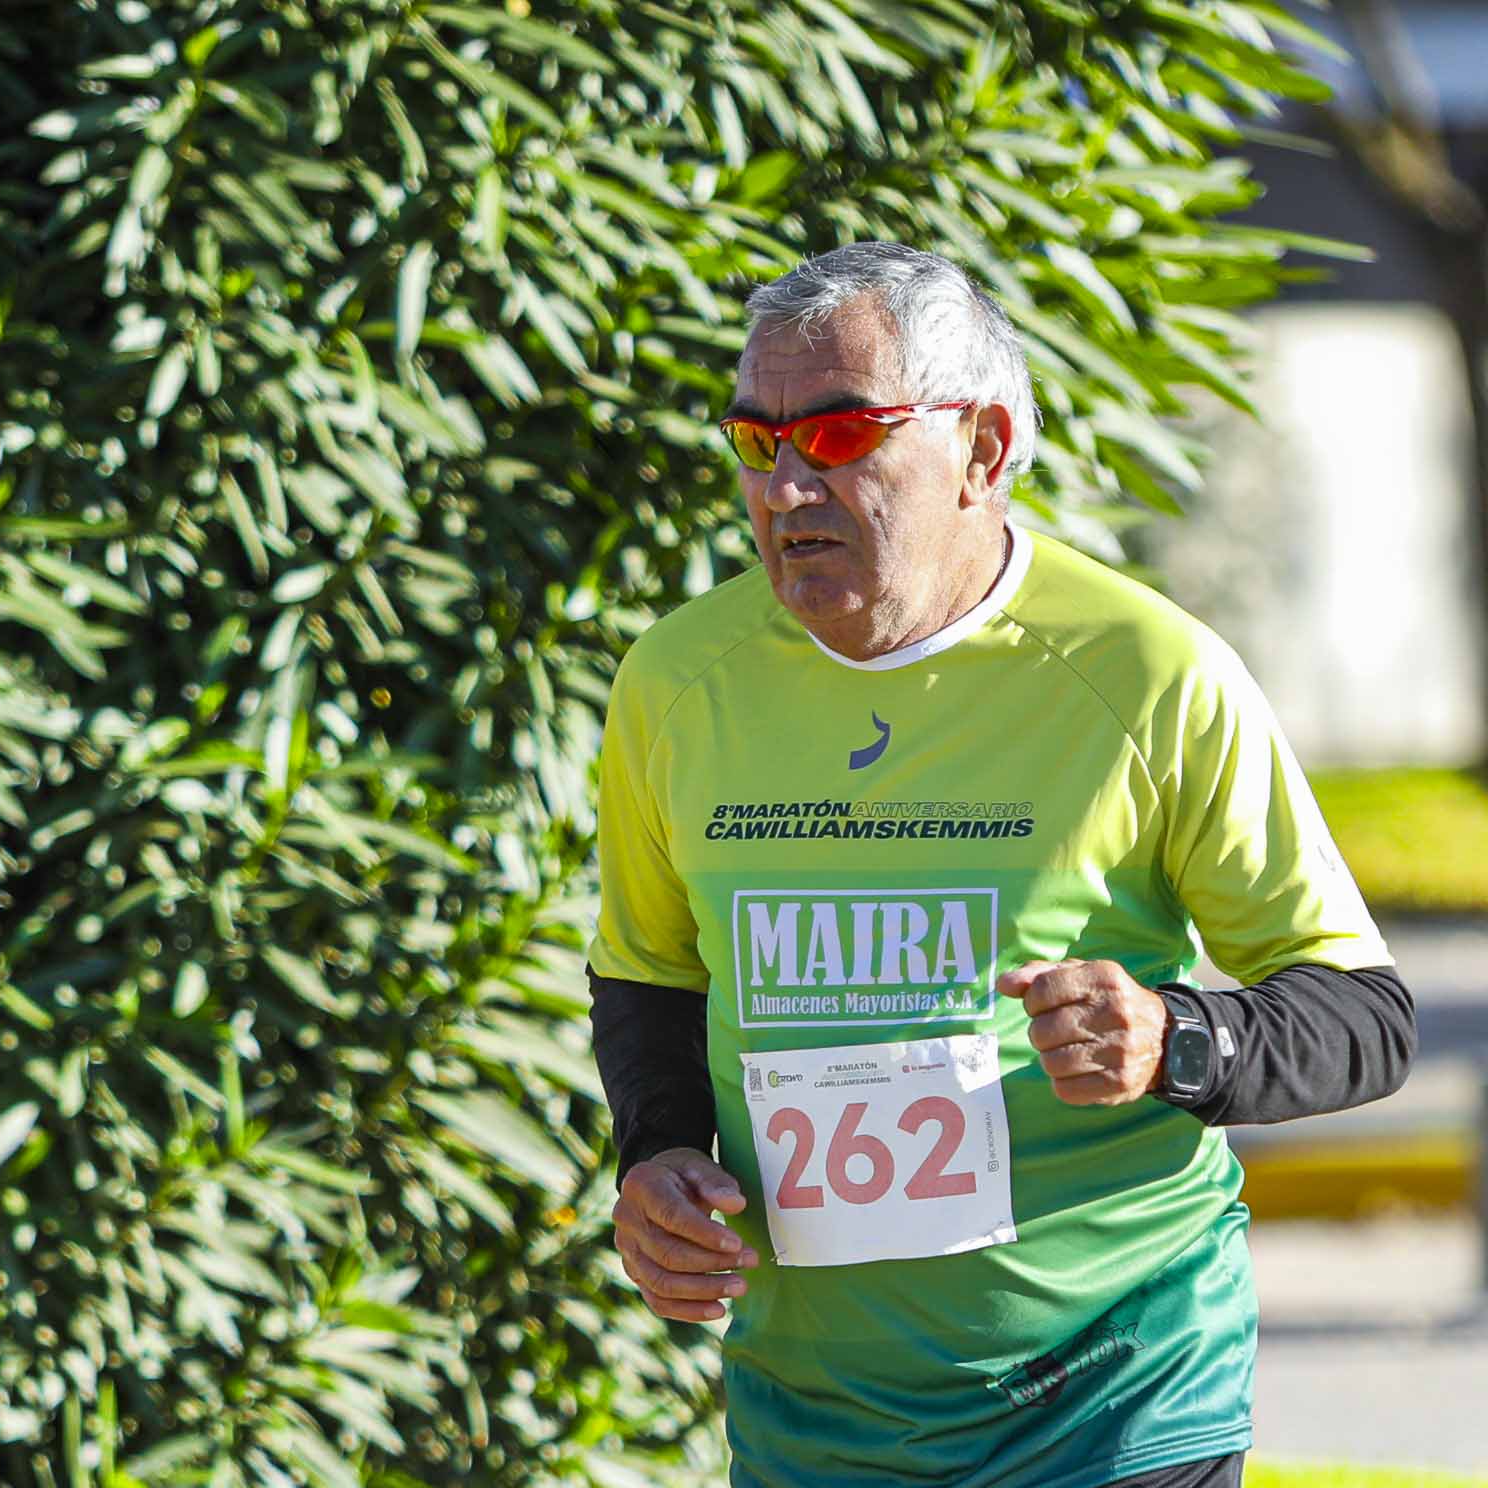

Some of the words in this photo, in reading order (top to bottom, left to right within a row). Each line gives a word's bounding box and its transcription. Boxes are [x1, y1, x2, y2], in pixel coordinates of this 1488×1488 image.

[705, 817, 1034, 840] CAWILLIAMSKEMMIS
[747, 901, 978, 987] MAIRA
[751, 993, 839, 1015] Almacenes
[845, 989, 939, 1014] Mayoristas
[766, 1096, 976, 1209] 262
